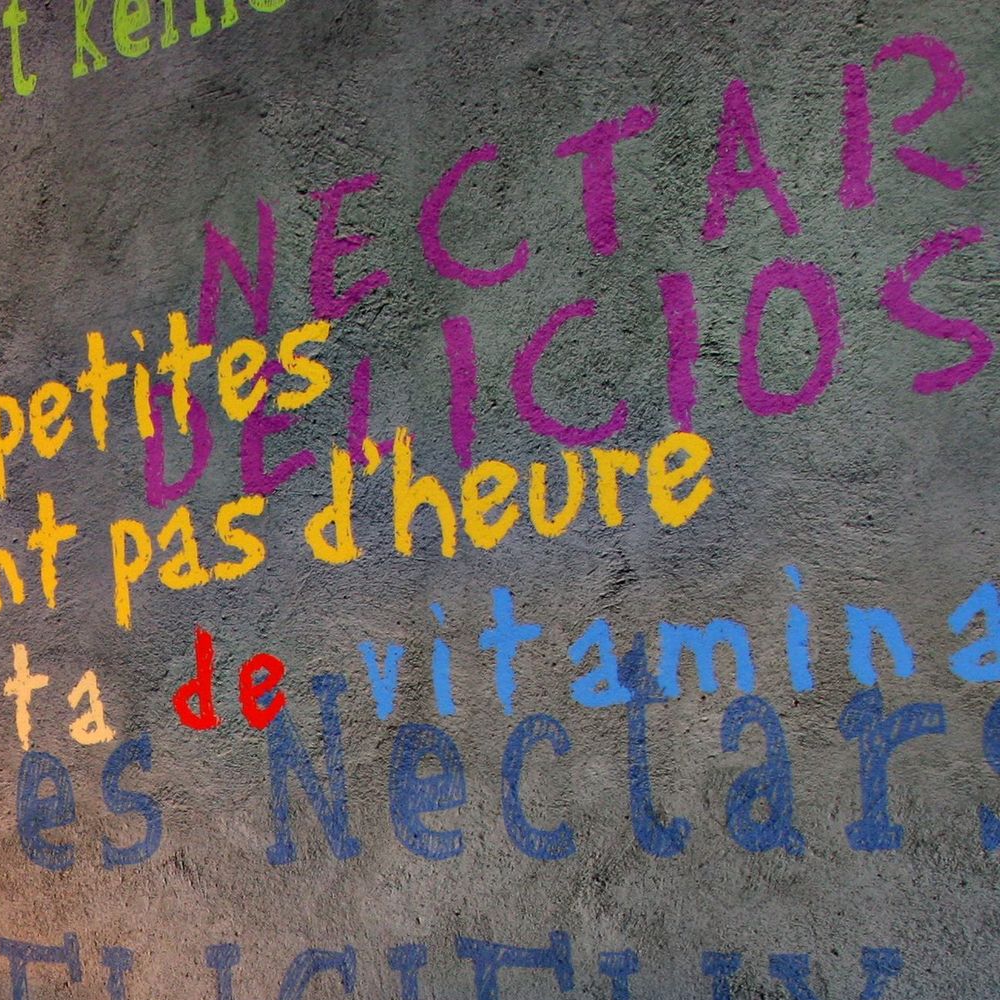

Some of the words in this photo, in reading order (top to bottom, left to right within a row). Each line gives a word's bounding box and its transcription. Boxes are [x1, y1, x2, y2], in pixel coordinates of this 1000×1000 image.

[200, 33, 977, 346] NECTAR
[143, 225, 995, 508] DELICIOS
[109, 494, 269, 630] pas
[304, 426, 714, 566] d'heure
[173, 627, 287, 731] de
